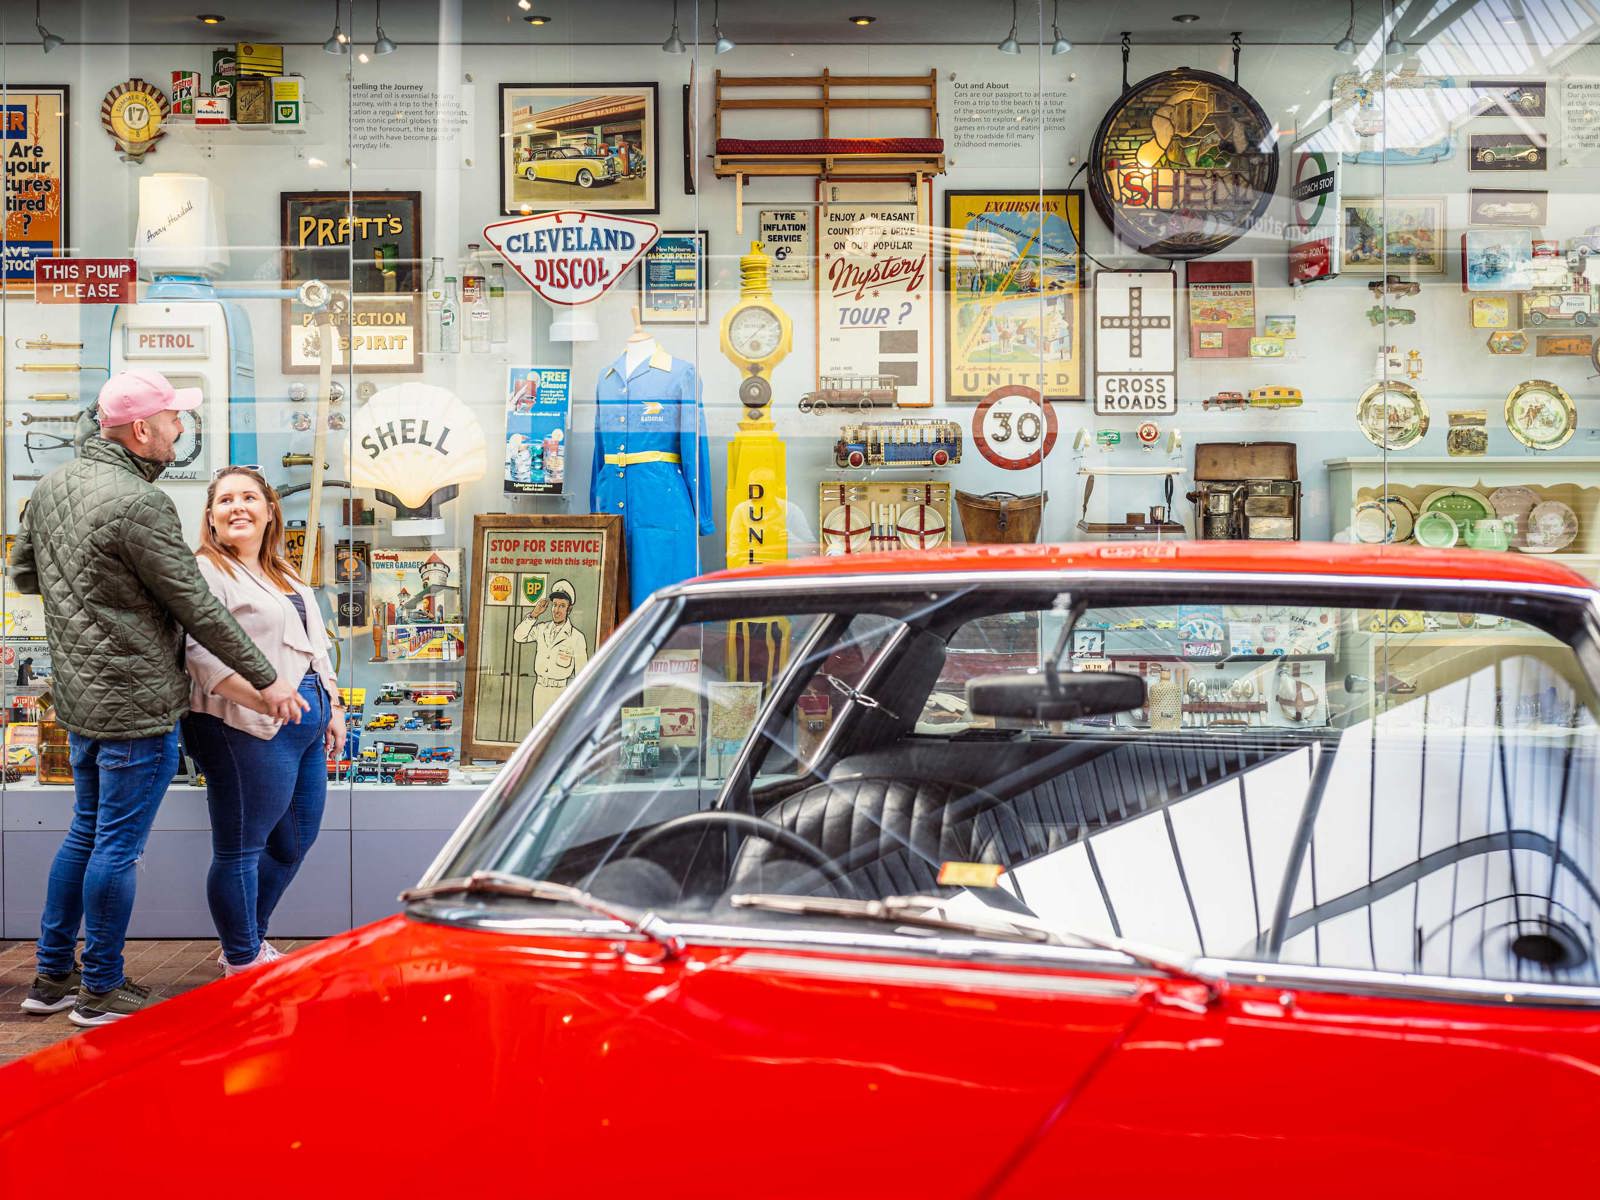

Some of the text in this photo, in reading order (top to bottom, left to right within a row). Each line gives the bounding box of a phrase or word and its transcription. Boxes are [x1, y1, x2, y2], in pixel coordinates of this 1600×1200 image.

[172, 79, 193, 92] Castrol
[380, 82, 393, 90] the
[394, 82, 425, 92] Journey
[954, 82, 1009, 90] Out and About
[172, 86, 192, 102] GTX
[281, 108, 292, 116] BP
[9, 142, 44, 158] Are
[5, 160, 51, 178] your
[5, 177, 52, 195] tyres
[1319, 177, 1334, 189] STOP
[5, 194, 46, 212] tired
[984, 201, 1060, 213] EXCURSIONS
[774, 212, 796, 221] TYRE
[829, 212, 856, 222] ENJOY
[860, 213, 866, 221] A
[22, 214, 32, 235] ?
[298, 213, 404, 250] PRATT'S
[763, 223, 807, 232] INFLATION
[506, 226, 636, 253] CLEVELAND
[767, 234, 802, 243] SERVICE
[833, 241, 846, 250] ON
[873, 241, 913, 250] POPULAR
[42, 264, 131, 279] THIS PUMP
[534, 256, 610, 290] DISCOL
[828, 254, 927, 301] Mystery
[52, 283, 120, 298] PLEASE
[839, 301, 912, 325] TOUR ?
[139, 334, 195, 348] PETROL
[337, 335, 408, 351] SPIRIT
[540, 371, 568, 382] FREE
[962, 373, 1070, 392] UNITED
[1105, 378, 1167, 393] CROSS
[1104, 395, 1168, 410] ROADS
[991, 412, 1041, 443] 30
[361, 418, 451, 460] SHELL
[491, 539, 600, 553] STOP FOR SERVICE
[372, 561, 394, 569] TOWER
[500, 557, 514, 565] the
[516, 559, 543, 567] garage
[544, 557, 562, 565] with
[565, 557, 581, 566] this
[582, 558, 598, 567] sign
[493, 584, 509, 592] SHELL
[526, 582, 542, 595] BP
